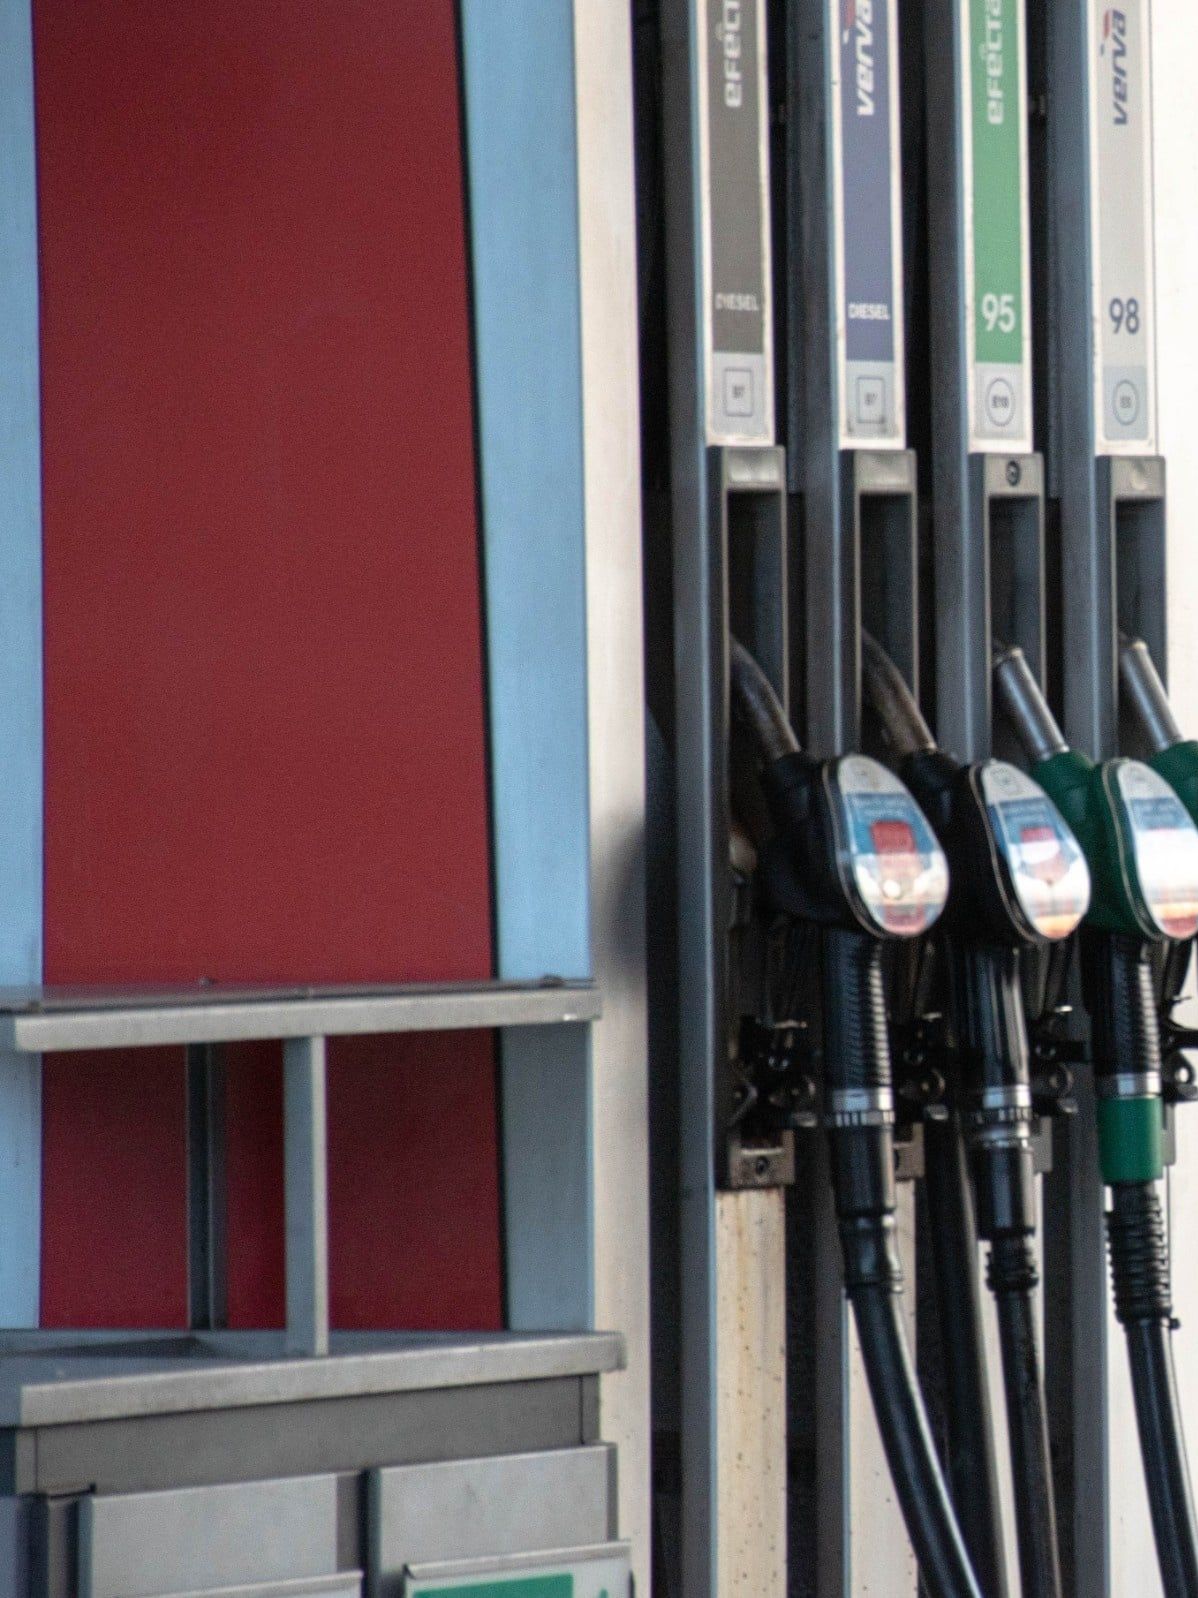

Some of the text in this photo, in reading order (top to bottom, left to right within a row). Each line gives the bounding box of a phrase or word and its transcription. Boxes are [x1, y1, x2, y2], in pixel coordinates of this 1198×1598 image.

[855, 0, 875, 116] verva
[1112, 9, 1129, 126] verva
[715, 293, 760, 312] DIESEL
[848, 302, 891, 321] DIESEL
[981, 293, 1017, 334] 95
[1109, 297, 1141, 335] 98
